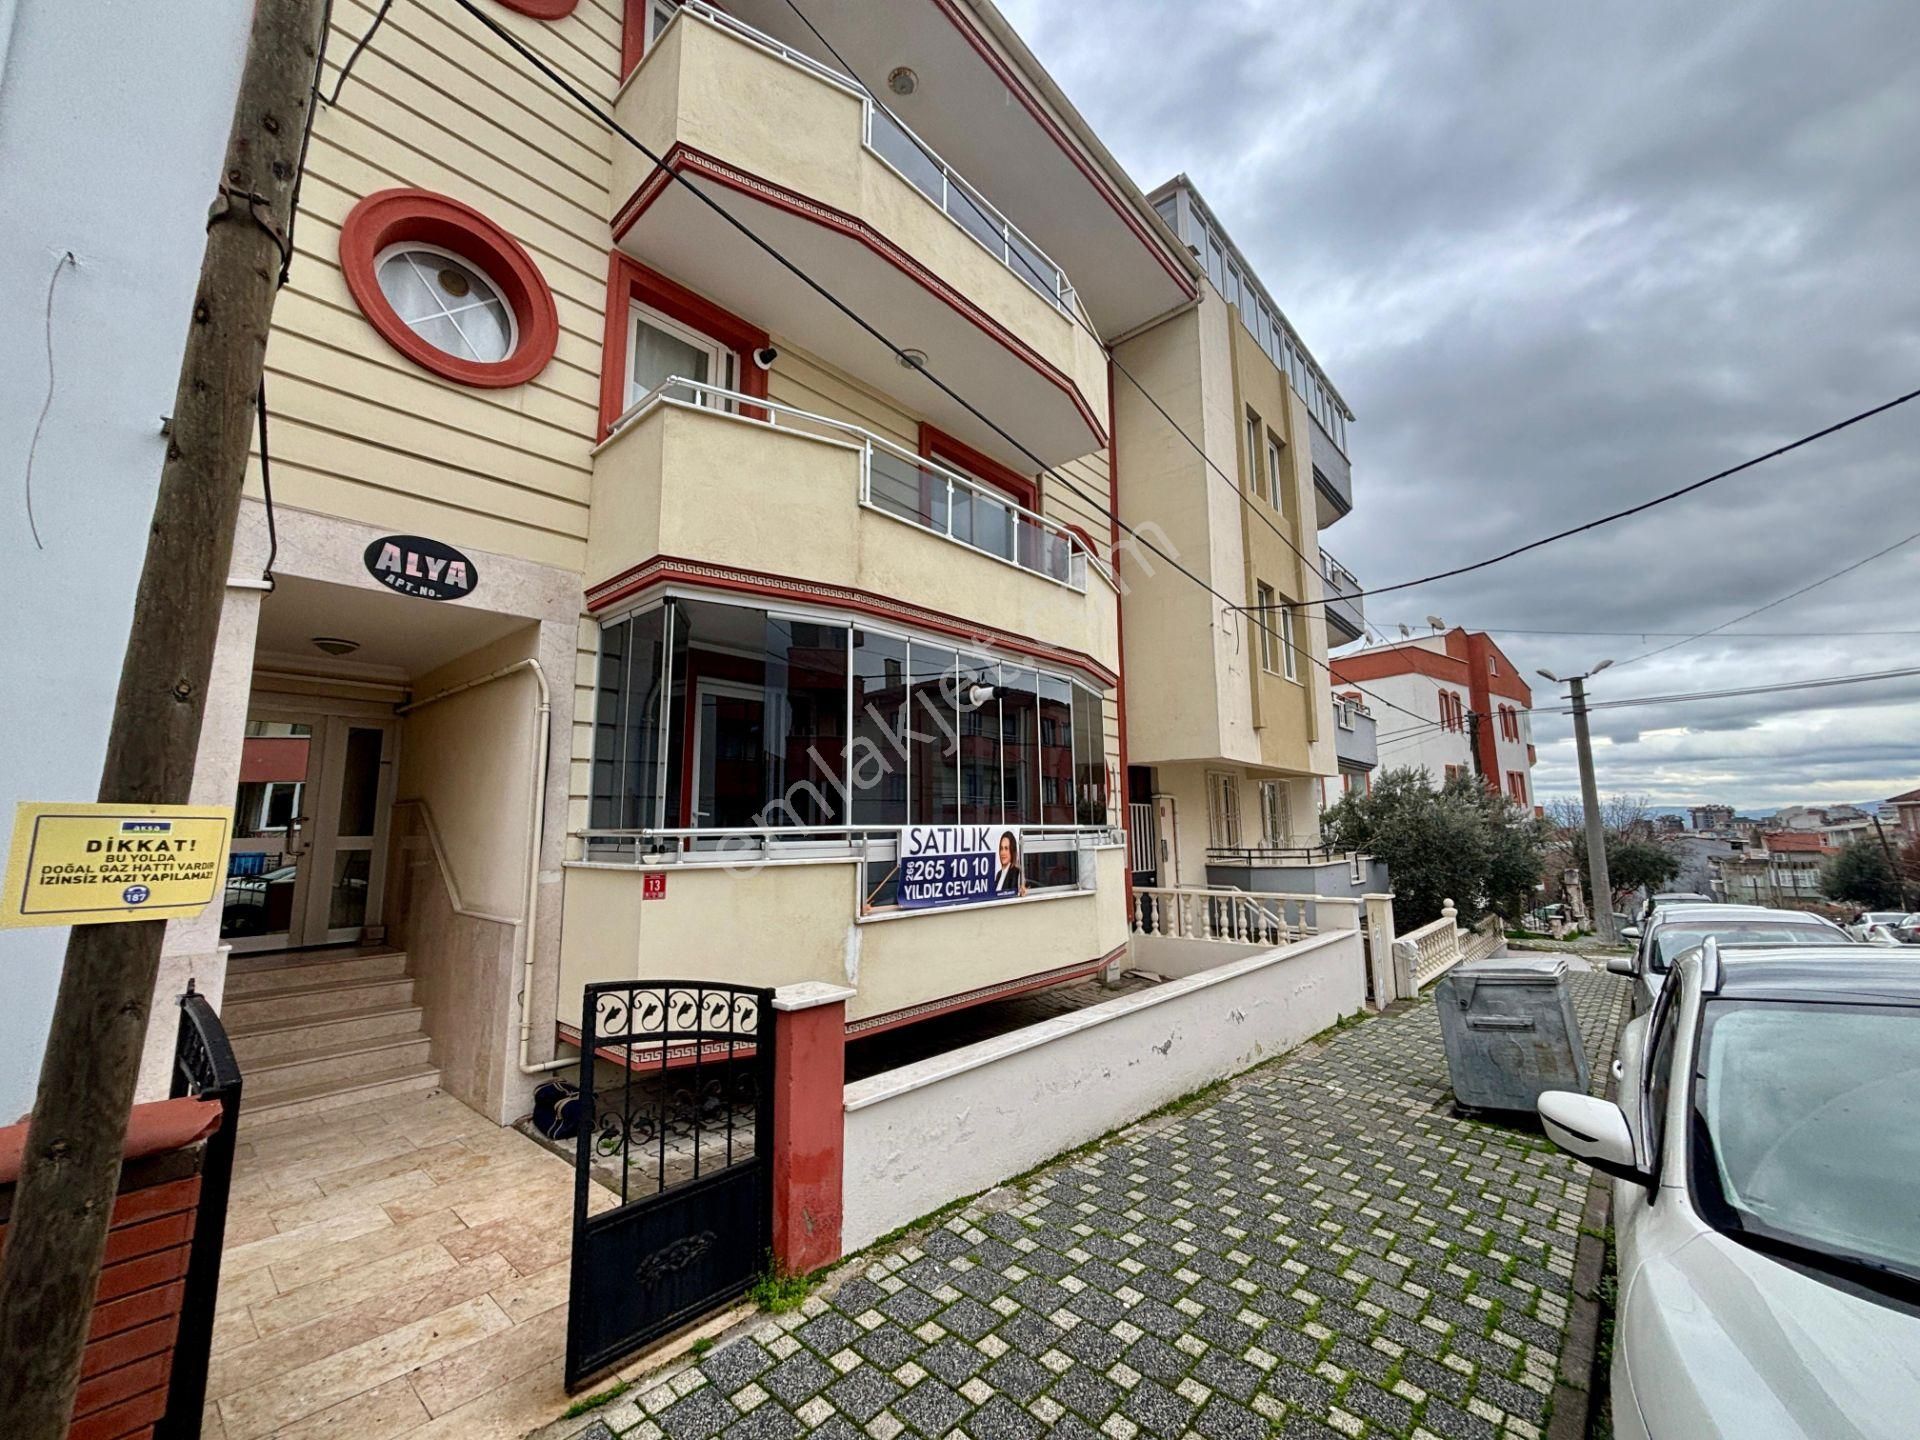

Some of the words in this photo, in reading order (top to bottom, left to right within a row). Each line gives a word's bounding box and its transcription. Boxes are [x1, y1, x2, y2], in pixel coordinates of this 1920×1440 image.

[375, 542, 468, 590] ALYA
[86, 837, 196, 853] DİKKAT!
[909, 827, 991, 855] SATILIK
[105, 853, 126, 863] BU
[130, 853, 175, 862] YOLDA
[41, 863, 95, 874] DOĞAL
[99, 864, 128, 873] GAZ
[132, 863, 174, 872] HATTI
[177, 862, 215, 870] VARDIR
[914, 860, 945, 881] 265
[950, 858, 968, 879] 10
[972, 857, 989, 876] 10
[40, 873, 97, 885] İZİNSİZ
[101, 874, 137, 883] KAZI
[649, 879, 661, 892] 13
[904, 883, 943, 900] YILDIZ
[945, 879, 988, 896] CEYLAN
[126, 893, 146, 902] 187
